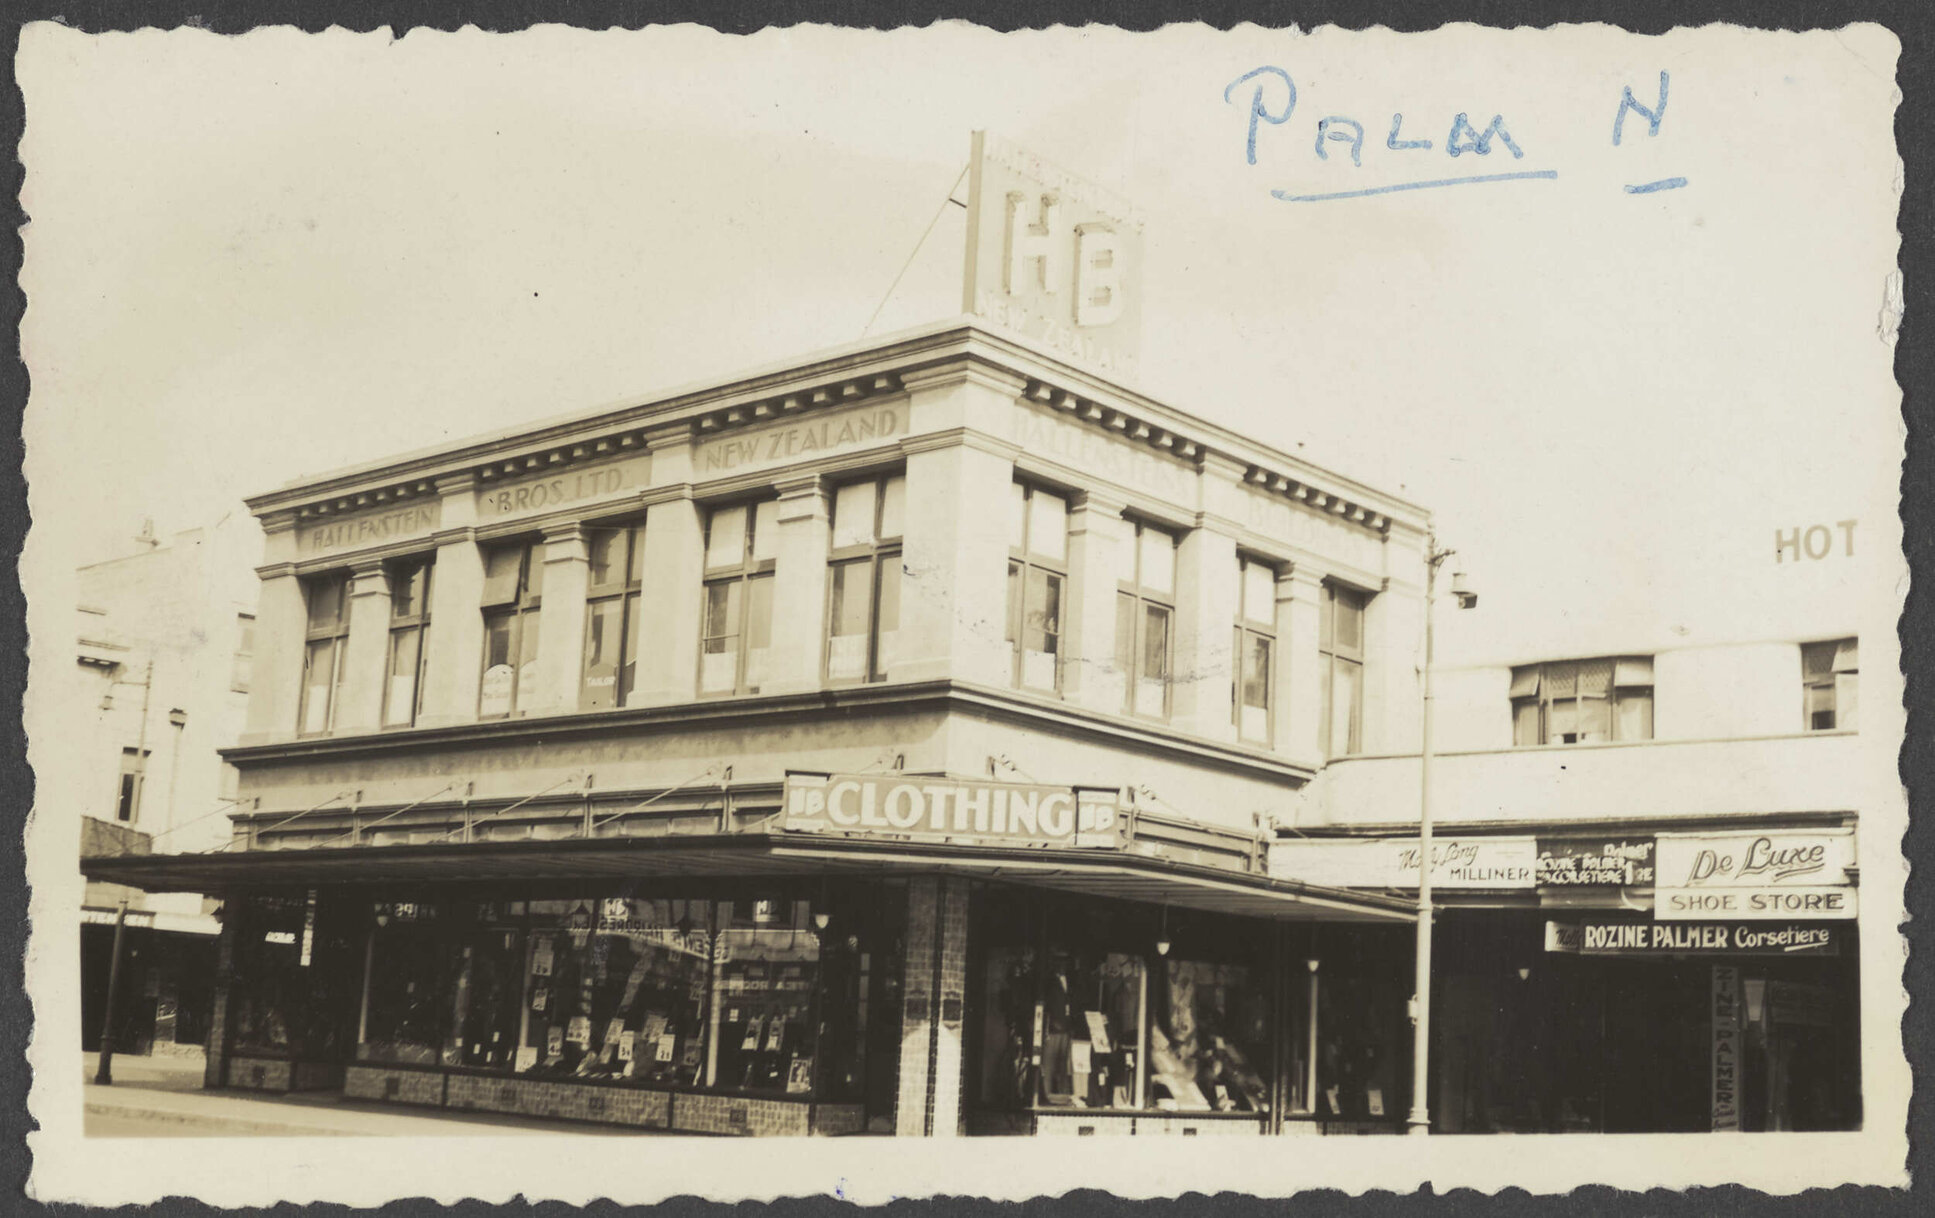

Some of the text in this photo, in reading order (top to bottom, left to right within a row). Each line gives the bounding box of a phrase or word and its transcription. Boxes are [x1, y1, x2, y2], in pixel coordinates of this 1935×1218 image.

[1224, 66, 1670, 166] PALM N
[312, 507, 434, 550] HALLENSTEIN
[706, 436, 762, 472] NEW
[768, 410, 898, 462] ZEALAND
[1775, 519, 1858, 564] HOT
[826, 780, 1074, 837] CLOTHING
[1449, 867, 1530, 881] MILLINER
[1687, 837, 1825, 886] De Luxe
[1671, 893, 1845, 912] SHOE STORE
[1585, 925, 1830, 951] ROZINE PALMER Corsetiere
